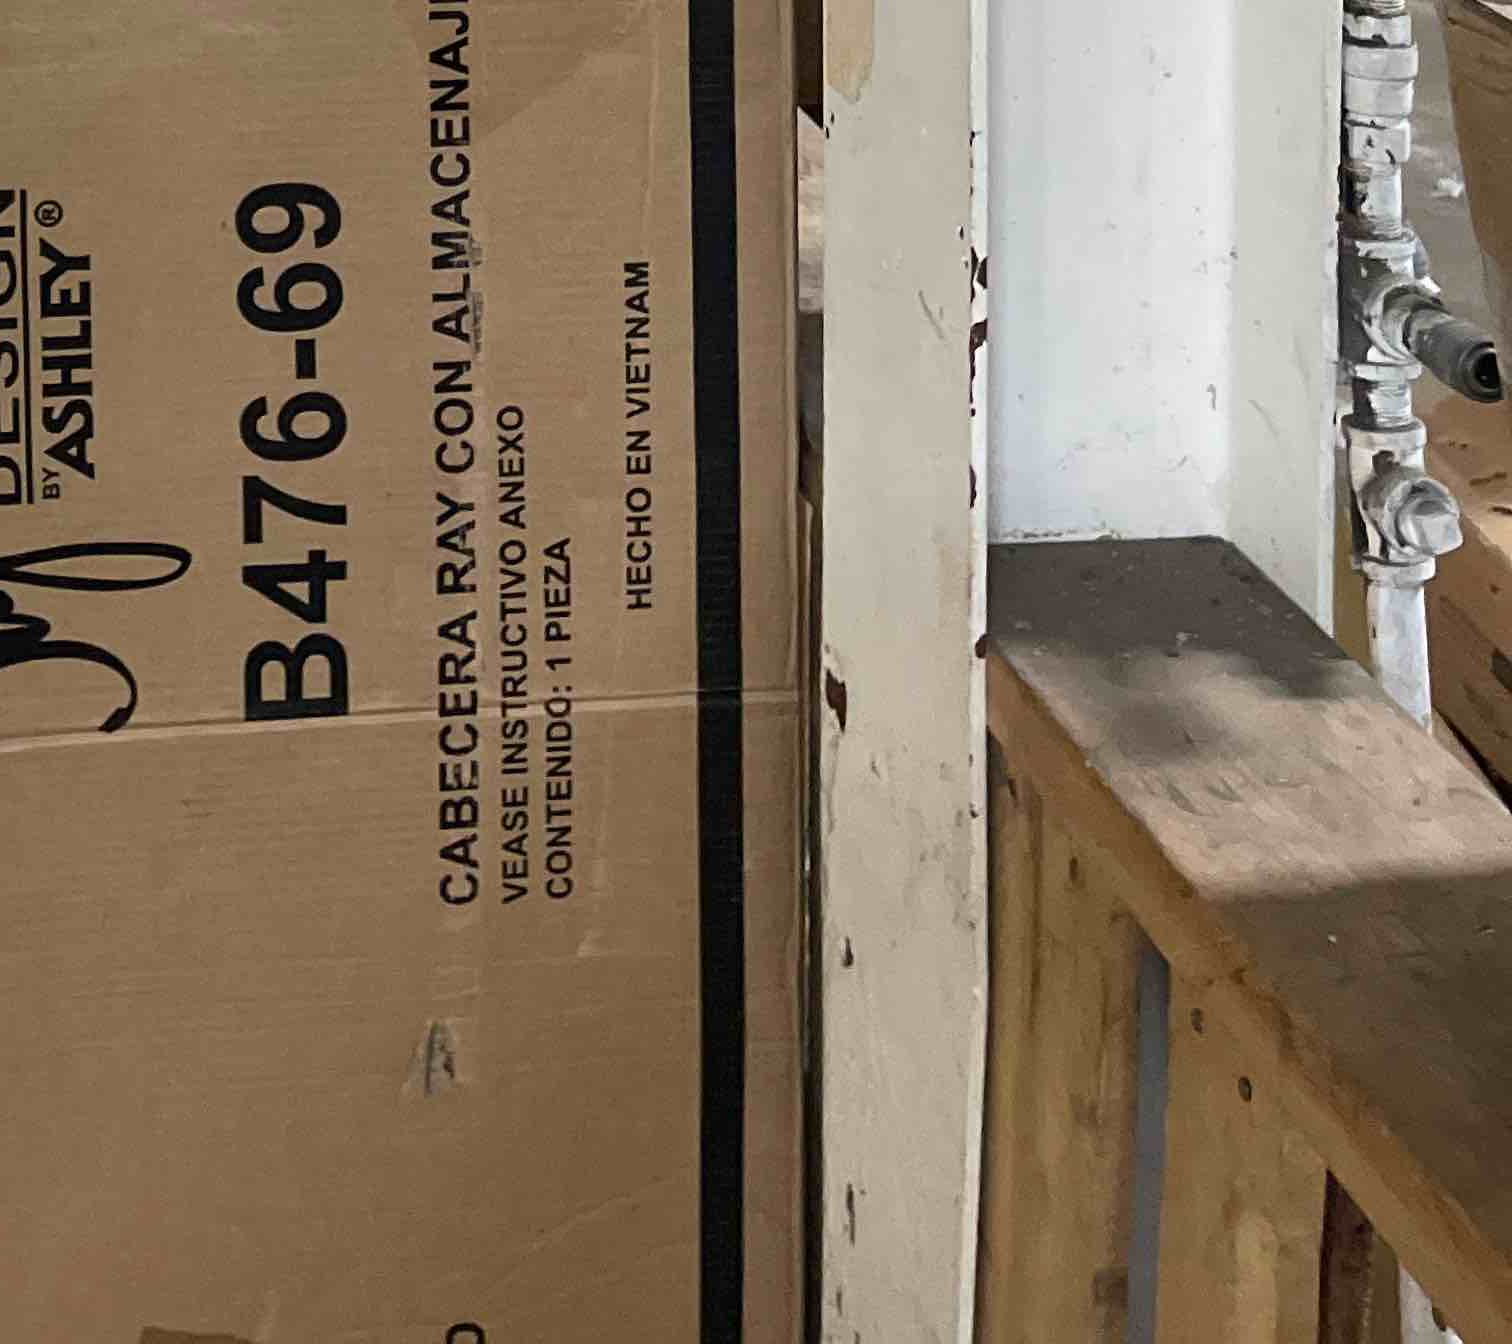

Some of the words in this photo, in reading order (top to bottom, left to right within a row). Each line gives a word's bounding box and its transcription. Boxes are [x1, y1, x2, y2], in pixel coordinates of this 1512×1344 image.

[624, 263, 650, 418] VIETNAM
[236, 183, 348, 722] B476-69
[433, 361, 474, 473] CON
[497, 406, 525, 529] ANEXO
[627, 431, 651, 474] EN
[42, 468, 60, 499] BY
[436, 492, 476, 594] RAY
[544, 538, 570, 641] PIEZA
[626, 488, 651, 609] HECHO
[500, 540, 528, 774] INSTRUCTIVO
[546, 658, 571, 670] 1
[438, 611, 478, 905] CABECERA
[544, 686, 572, 898] CONTENIDO:
[502, 787, 528, 904] VEASE
